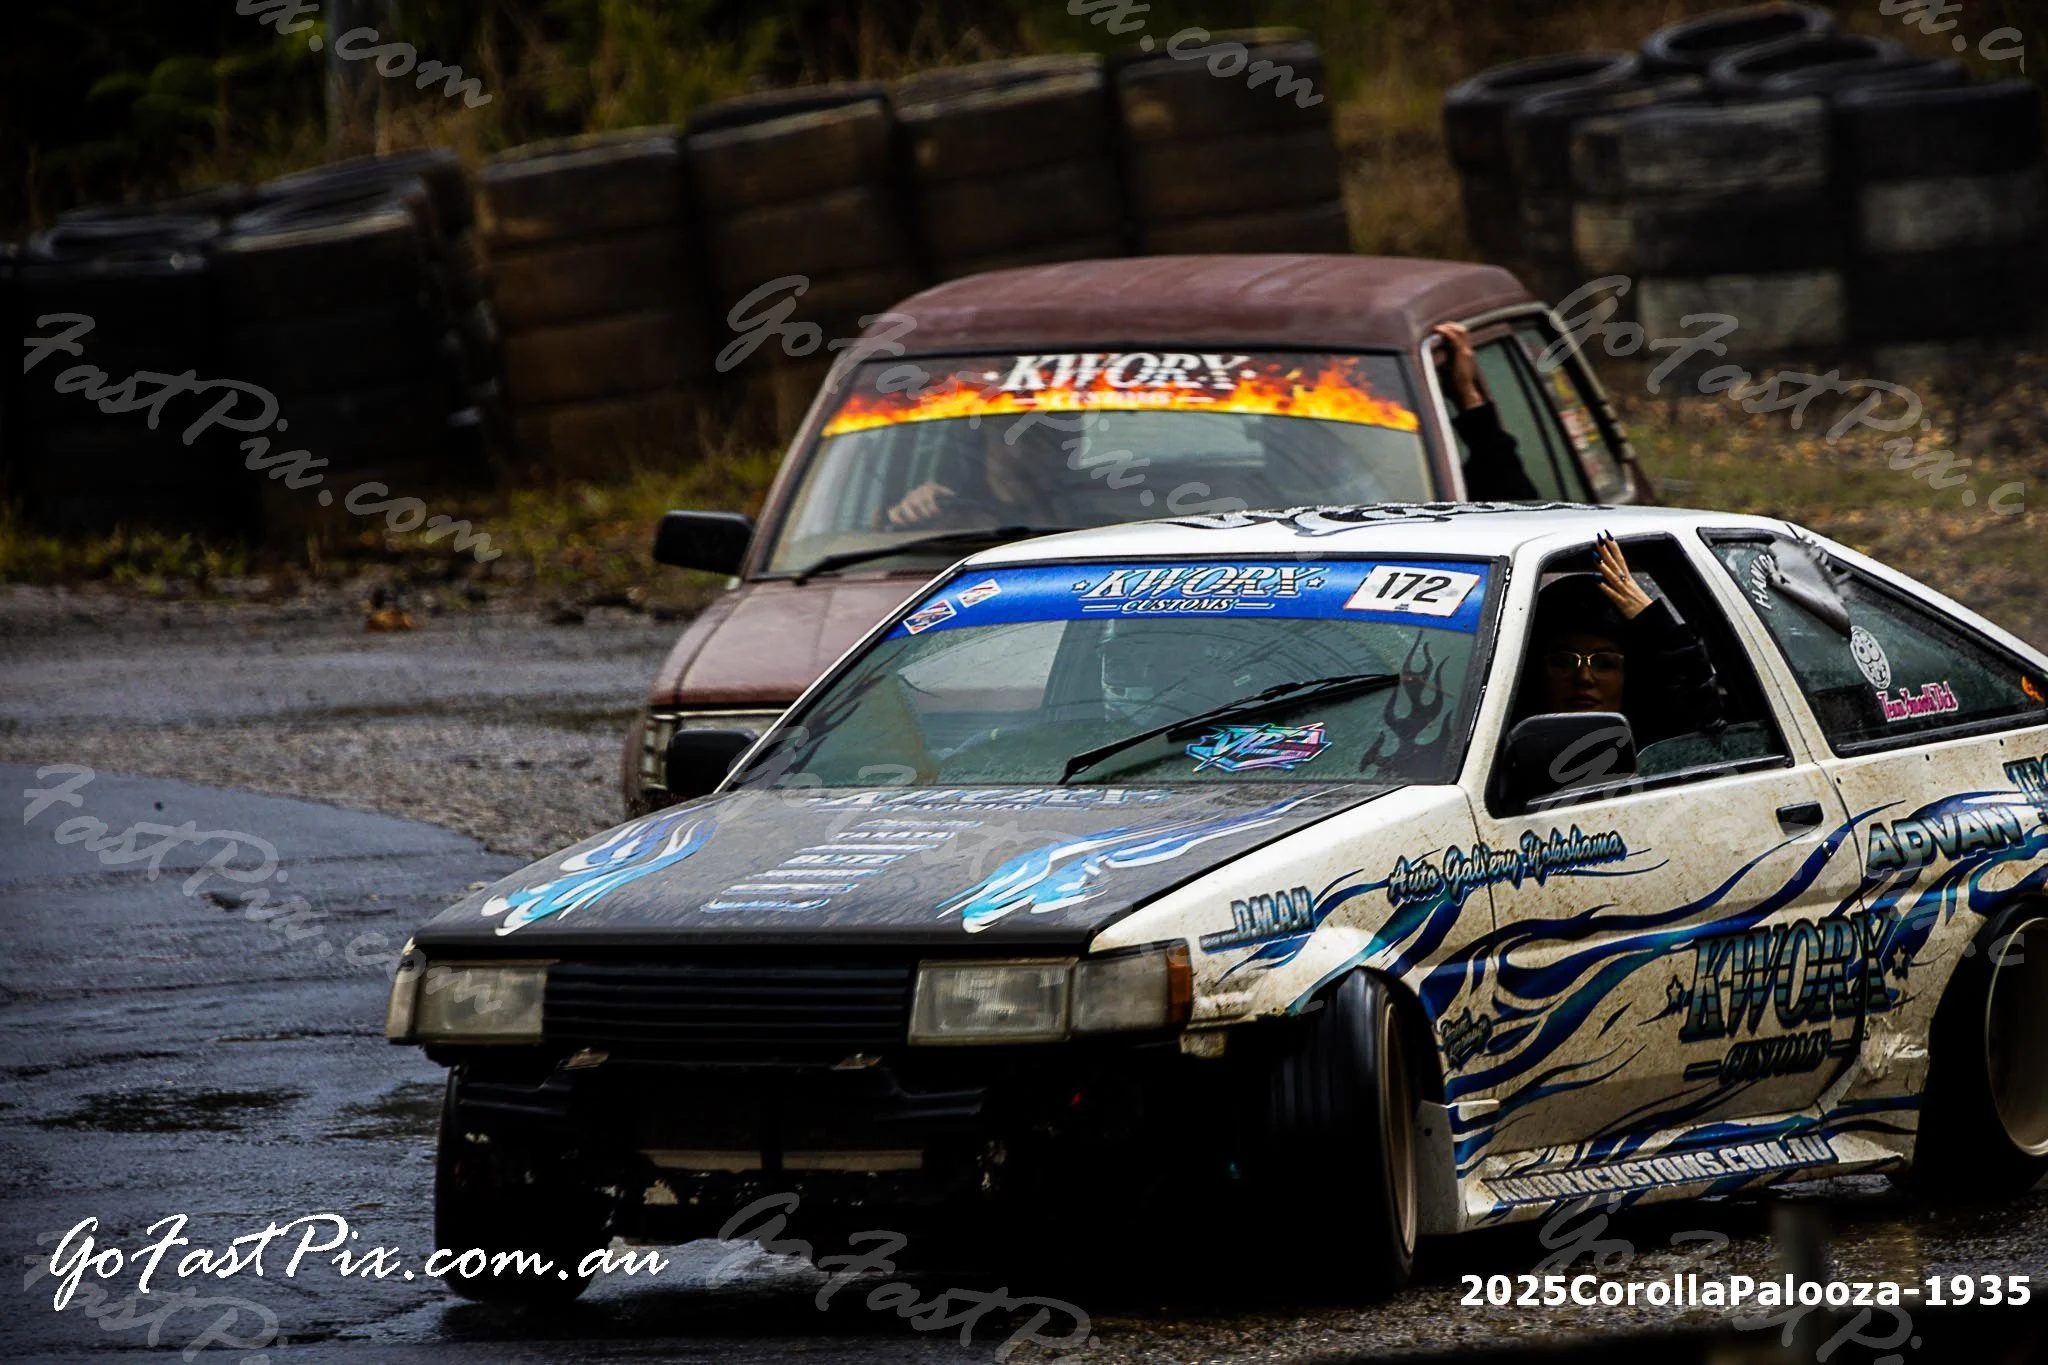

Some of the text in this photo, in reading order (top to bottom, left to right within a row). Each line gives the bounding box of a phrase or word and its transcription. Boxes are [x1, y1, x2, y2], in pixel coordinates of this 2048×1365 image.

[1119, 598, 1233, 614] CUSTOMS
[1376, 572, 1452, 603] 172
[1867, 805, 2026, 870] ADVAN
[1388, 855, 1443, 903] Auto
[1490, 1133, 1836, 1202] KWORXCUSTOMS.COM.AU
